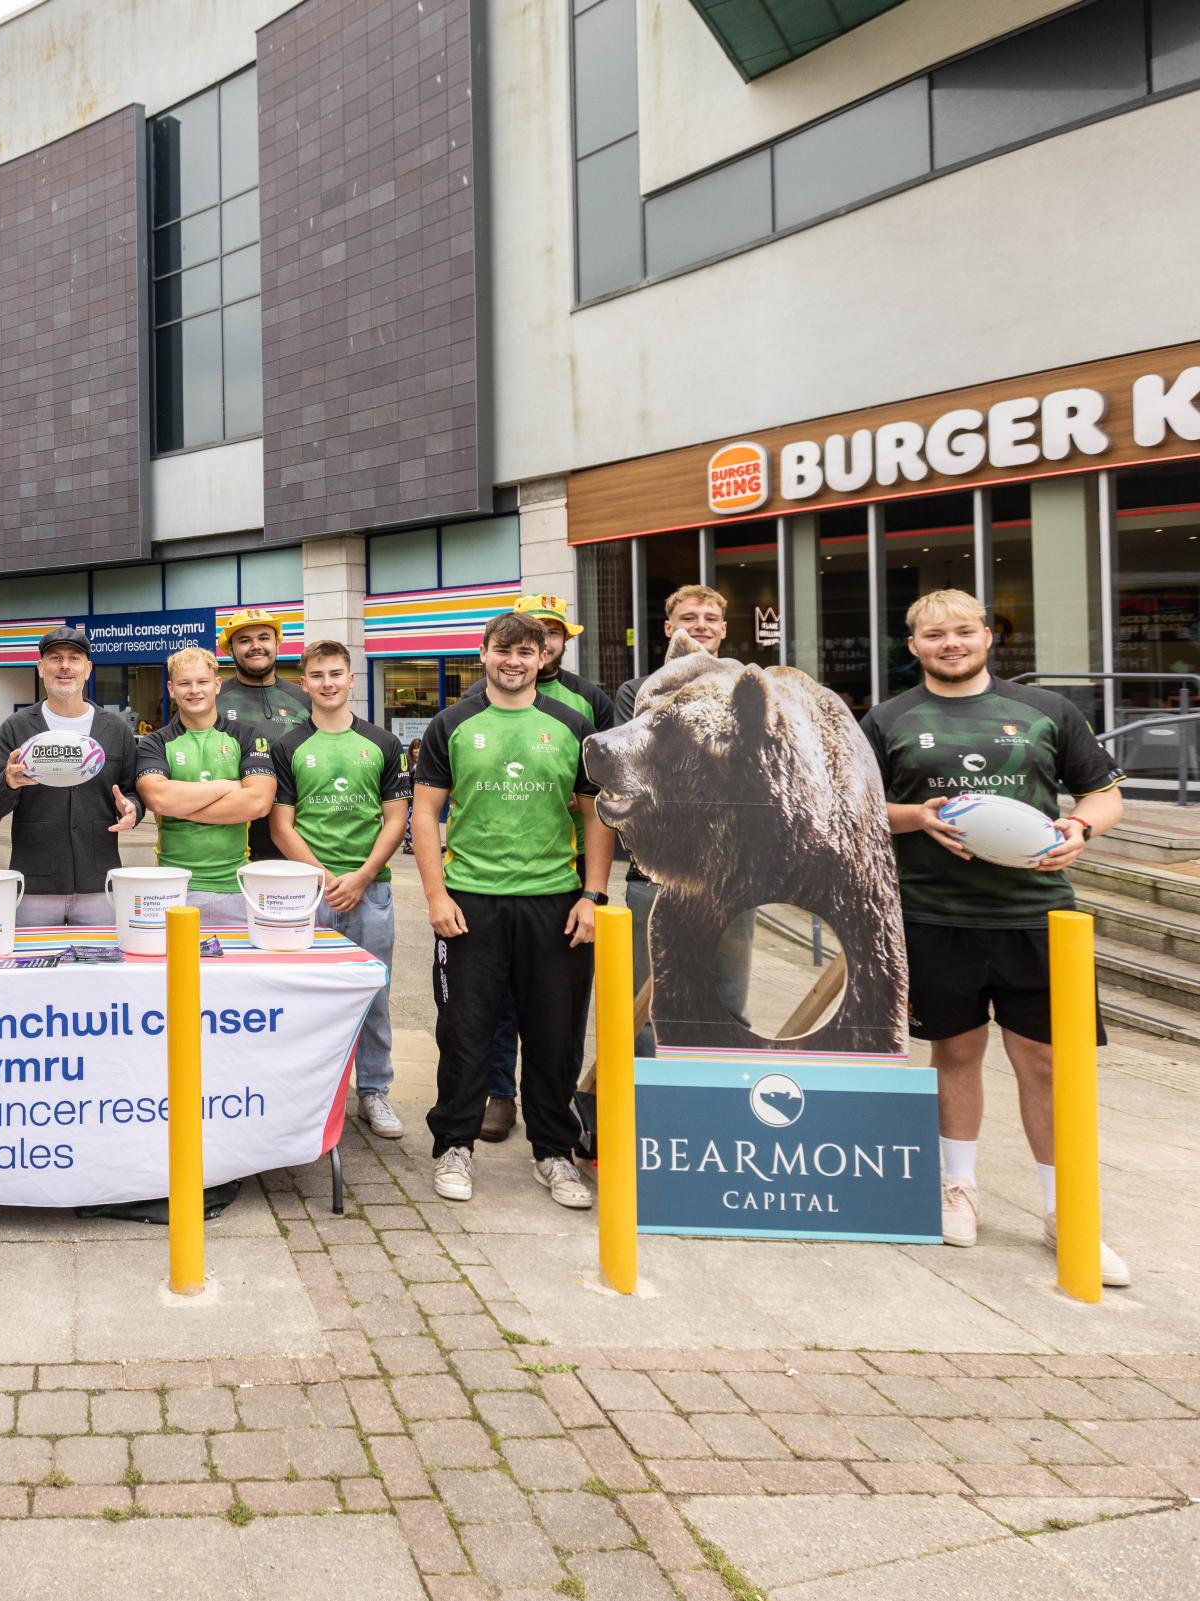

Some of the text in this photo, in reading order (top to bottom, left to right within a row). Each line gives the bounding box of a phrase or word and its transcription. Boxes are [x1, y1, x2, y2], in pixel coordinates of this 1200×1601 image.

[780, 387, 1109, 501] BURGER
[711, 462, 763, 482] BURGER
[711, 474, 762, 500] KING
[90, 623, 205, 641] ymchwil canser cymru
[90, 637, 199, 653] cancer research wales
[476, 781, 556, 794] BEARMONT
[928, 774, 1027, 789] BEARMONT
[308, 793, 373, 804] BEARMONT
[141, 1006, 284, 1037] cnser
[100, 1086, 265, 1124] reserch
[639, 1137, 920, 1182] BEARMONT
[723, 1190, 839, 1213] CAPITAL
